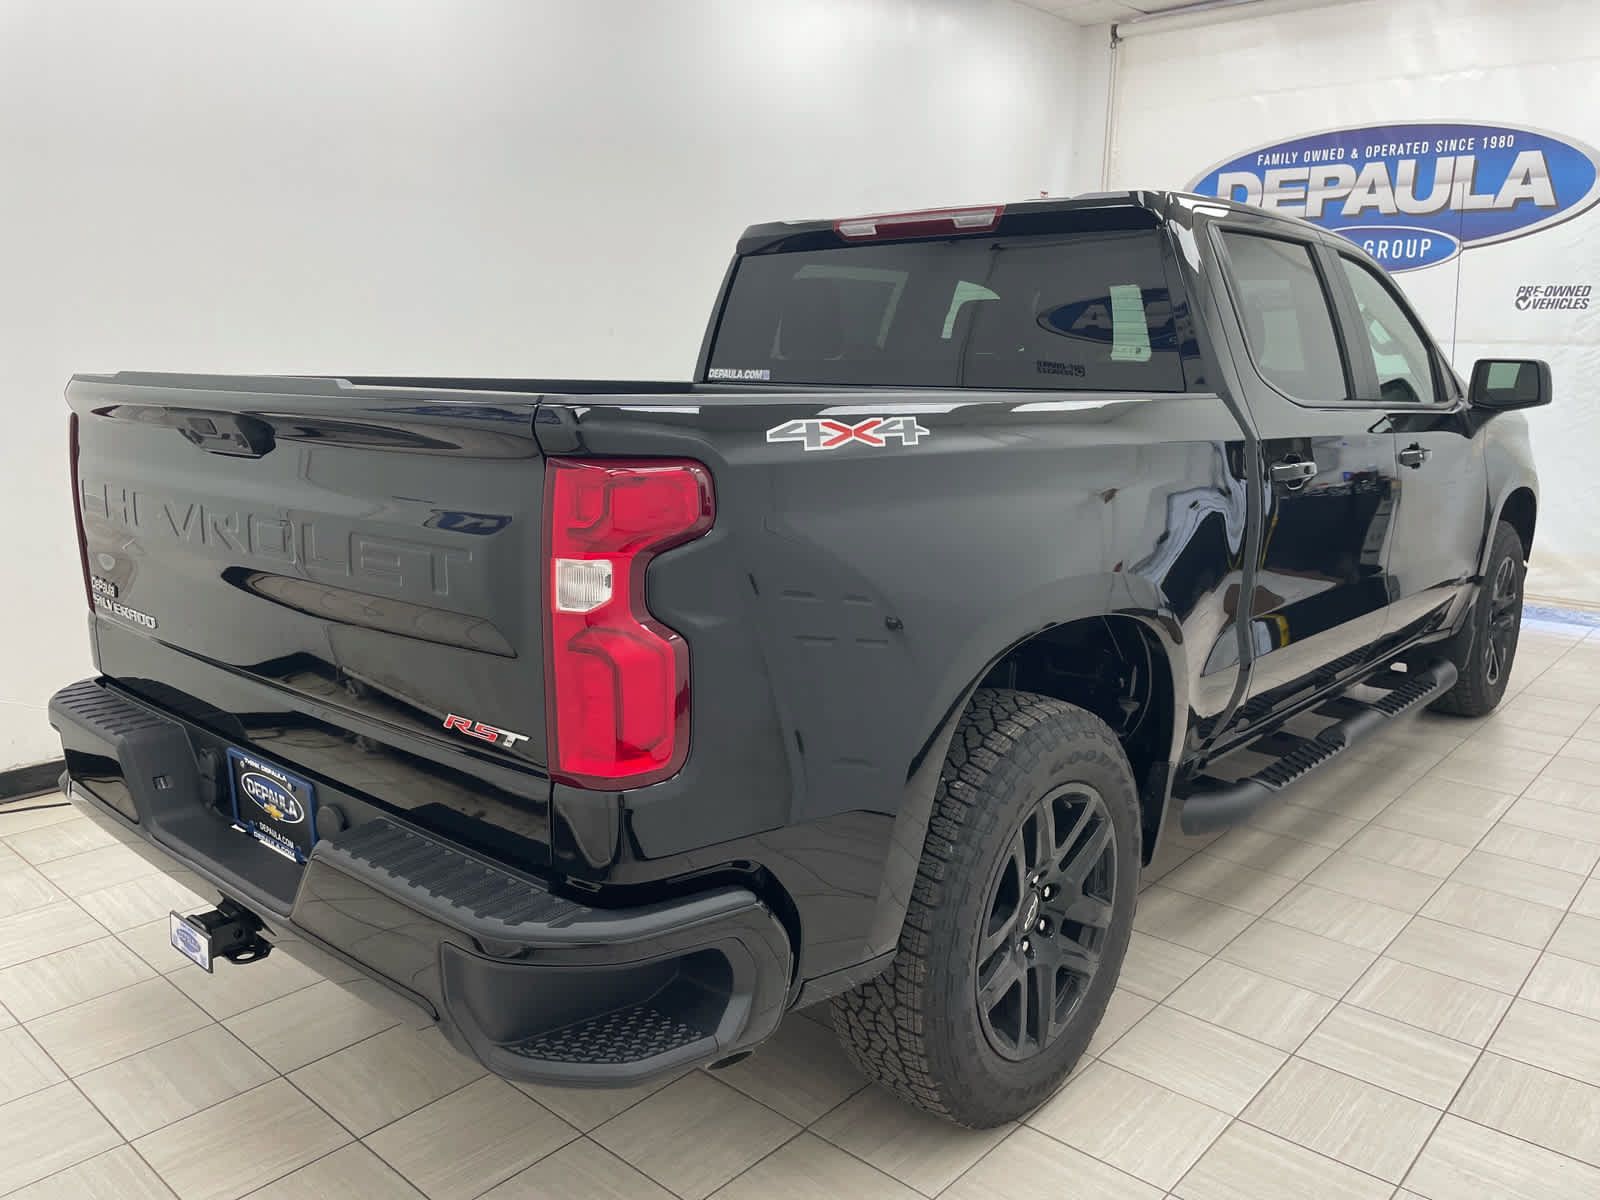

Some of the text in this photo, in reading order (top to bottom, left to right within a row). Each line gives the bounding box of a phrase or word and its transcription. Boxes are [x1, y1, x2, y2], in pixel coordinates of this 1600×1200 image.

[1257, 135, 1514, 166] FAMILY OWNED & OPERATED SINCE 1980
[1217, 150, 1557, 217] DEPAULA
[1363, 238, 1432, 259] GROUP
[1516, 285, 1592, 297] PRE-OWNED
[1531, 298, 1590, 310] VEHICLES
[708, 368, 763, 379] DEPAULA.COM
[93, 592, 158, 629] SILVERADO
[443, 713, 530, 748] RST
[246, 777, 298, 819] DEPAULA
[259, 821, 295, 849] DEPAULA.COM
